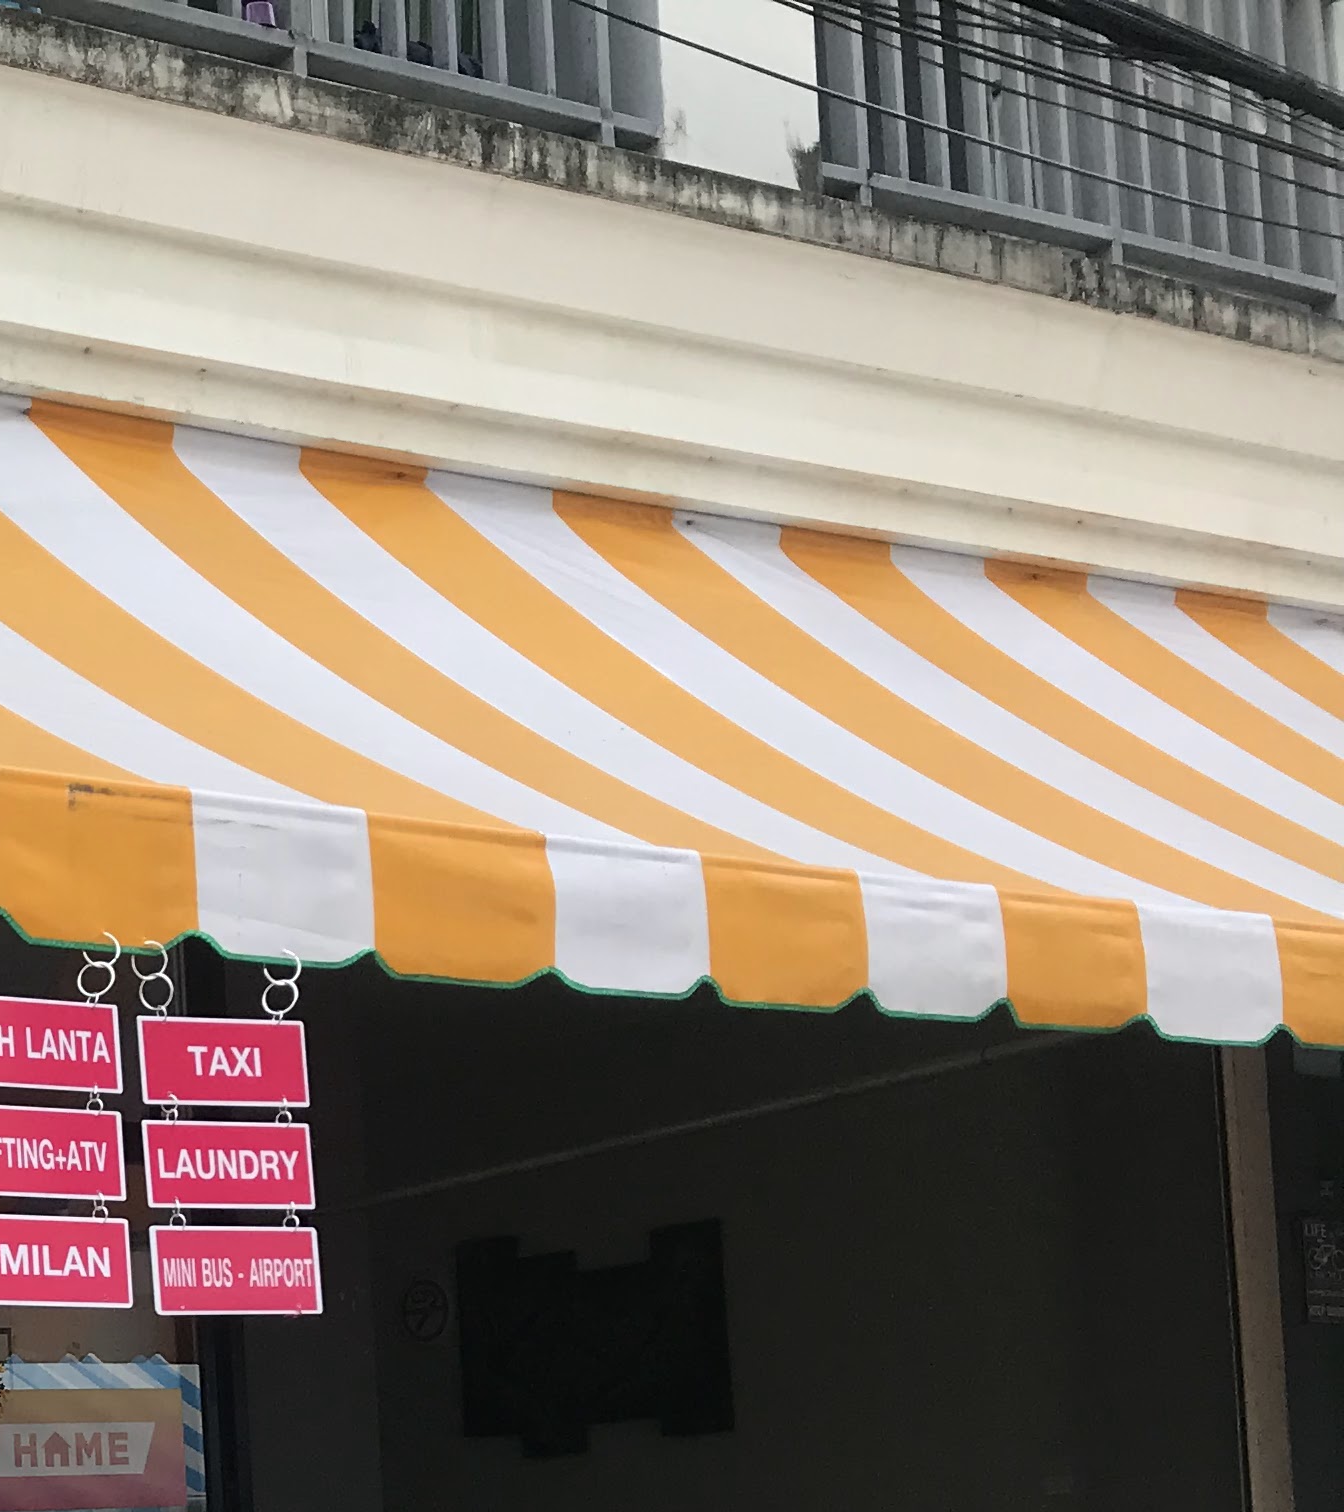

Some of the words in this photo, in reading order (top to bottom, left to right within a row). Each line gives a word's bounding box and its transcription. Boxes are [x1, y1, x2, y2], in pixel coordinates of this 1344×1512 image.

[25, 1028, 112, 1064] LANTA
[187, 1045, 262, 1077] TAXI
[157, 1148, 299, 1181] LAUNDRY
[162, 1257, 197, 1288] MINI
[201, 1257, 234, 1288] BUS
[249, 1258, 313, 1288] AIRPORT
